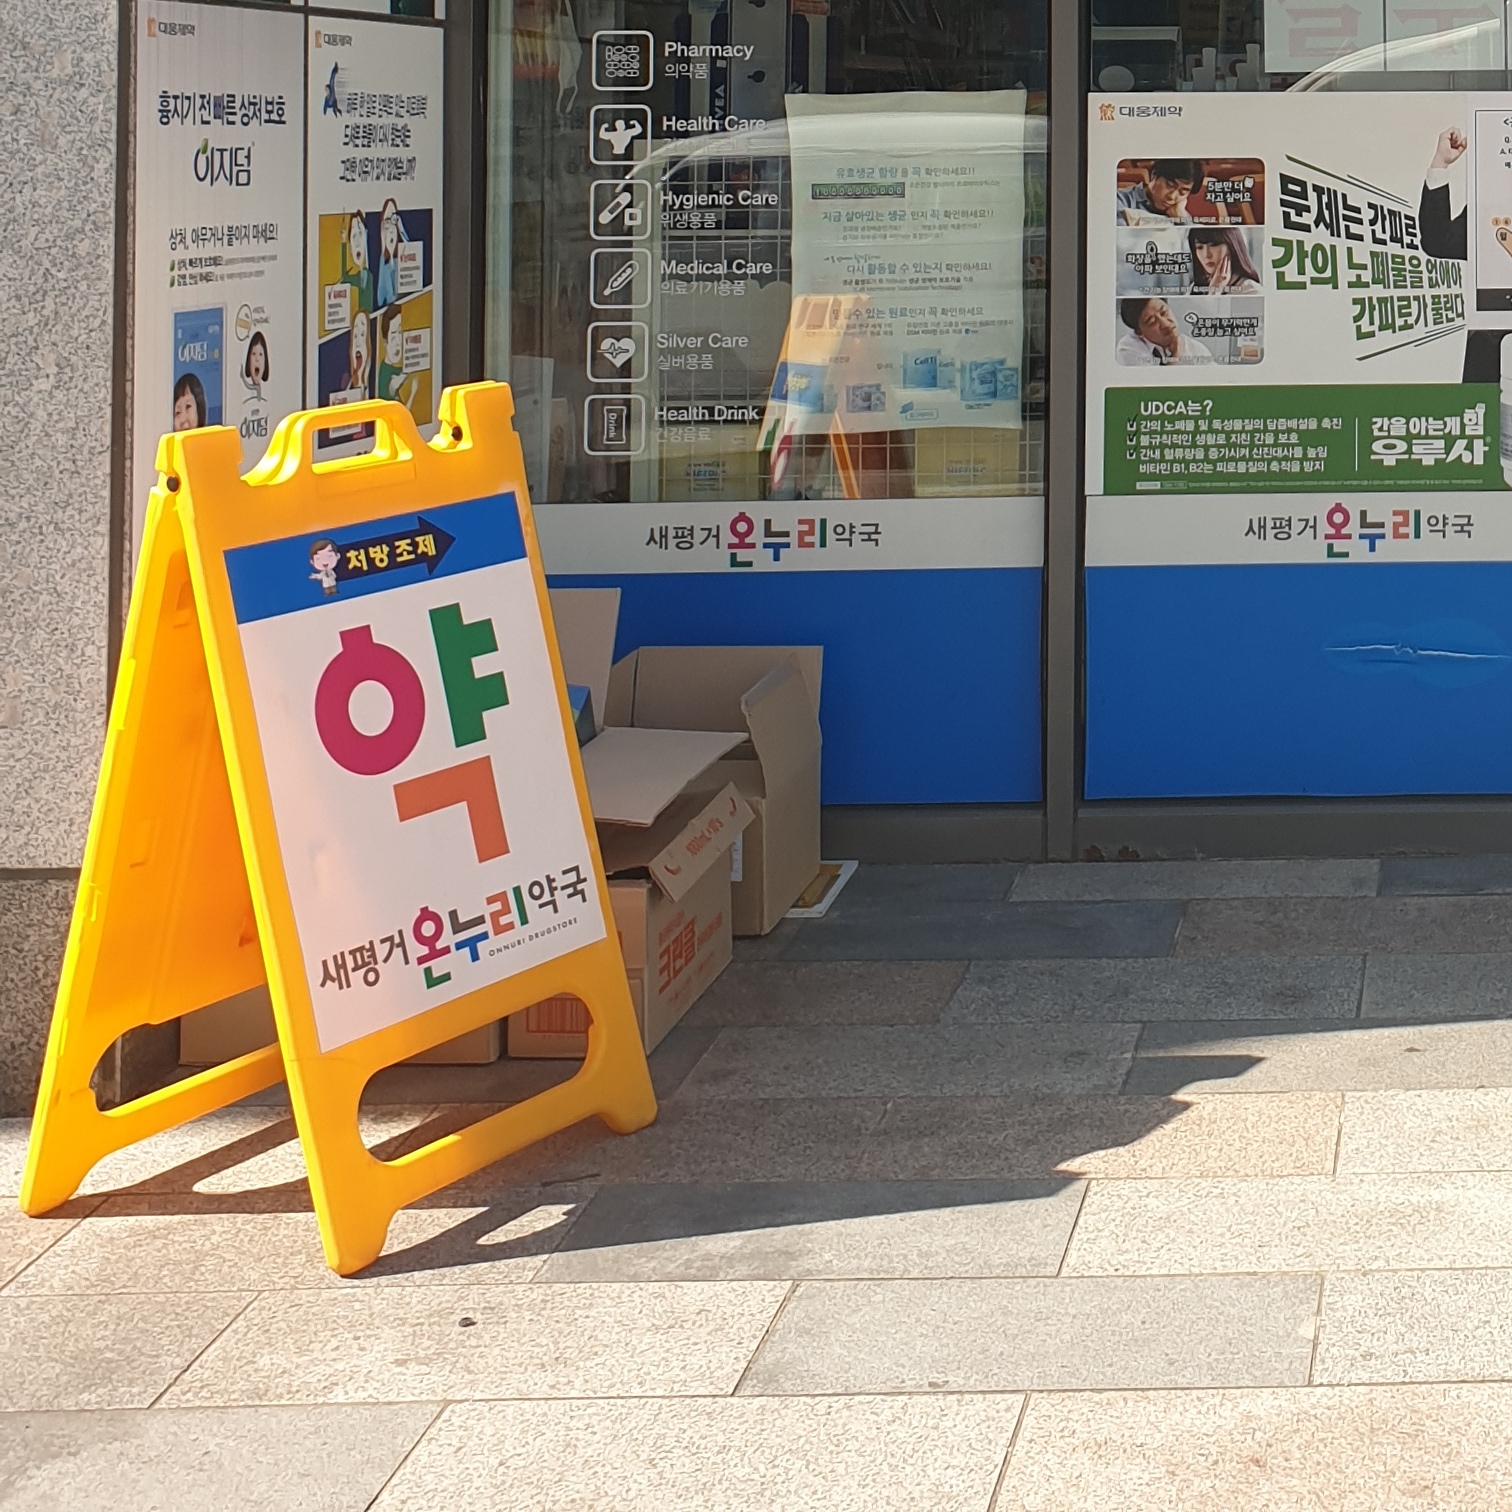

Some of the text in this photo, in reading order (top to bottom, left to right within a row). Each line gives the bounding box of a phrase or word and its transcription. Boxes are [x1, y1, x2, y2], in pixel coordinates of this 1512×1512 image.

[664, 42, 754, 60] Pharmacy
[665, 63, 709, 79] 의약품
[157, 91, 196, 126] 흉지기
[198, 91, 212, 126] 전
[238, 93, 262, 127] 상처
[263, 96, 287, 125] 보호
[1118, 106, 1183, 118] 대웅제약
[662, 116, 766, 131] Health Care
[193, 141, 254, 187] 이지덤
[660, 190, 779, 209] Hygienic Care
[1206, 192, 1224, 202] 자고
[1279, 172, 1419, 250] 문제는 간피로
[661, 213, 717, 228] 위생용품
[169, 228, 189, 250] 상처,
[191, 225, 225, 249] 아무거나
[252, 223, 278, 245] 마세요!
[660, 259, 772, 275] Medical Care
[1271, 237, 1462, 290] 간의 노폐물을 없애야
[660, 280, 746, 296] 의료기기용품
[1352, 293, 1465, 340] 간피로가 풀린다
[656, 333, 749, 349] Silver Care
[657, 354, 714, 370] 실버용품
[655, 405, 759, 421] Health Drink
[1140, 399, 1213, 416] UDCA는?
[1140, 419, 1161, 431] 간의
[1371, 417, 1407, 437] 간을
[1463, 403, 1485, 436] 힘
[1278, 433, 1299, 445] 보호
[1370, 438, 1489, 466] 우루사
[1139, 462, 1170, 473] 비타민
[346, 533, 436, 571] 처방 조제
[314, 602, 510, 863] 약
